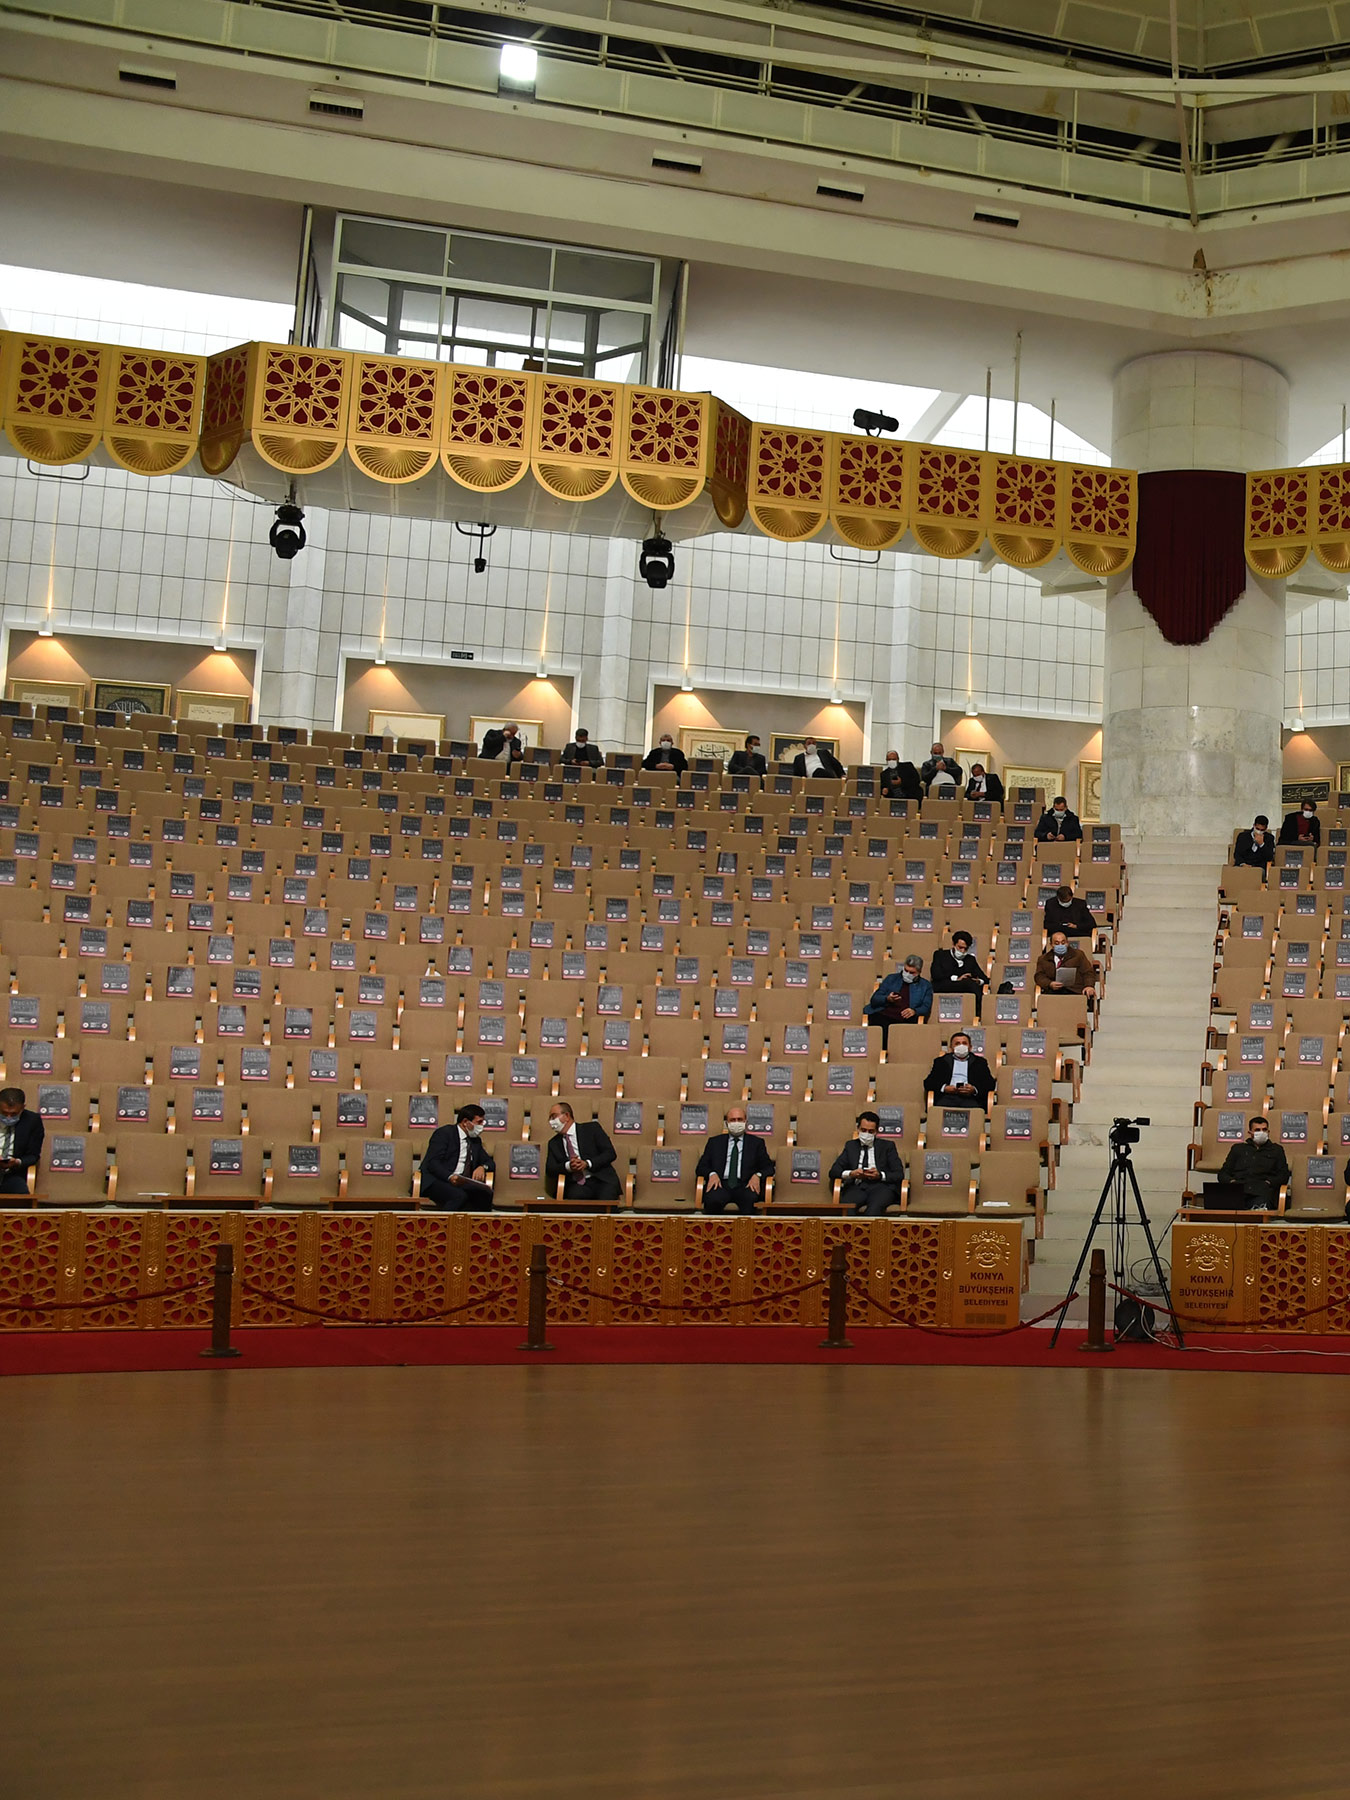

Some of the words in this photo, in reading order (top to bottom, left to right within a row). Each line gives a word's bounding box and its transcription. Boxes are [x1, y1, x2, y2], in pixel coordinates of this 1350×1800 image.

[970, 1271, 1004, 1281] KONYA
[1190, 1275, 1224, 1284] KONYA
[959, 1284, 1014, 1296] BÜYÜKŞEHİR
[1179, 1287, 1234, 1298] BÜYÜKŞEHİR
[964, 1297, 1008, 1306] BELEDİYESİ
[1184, 1300, 1228, 1309] BELEDİYESİ
